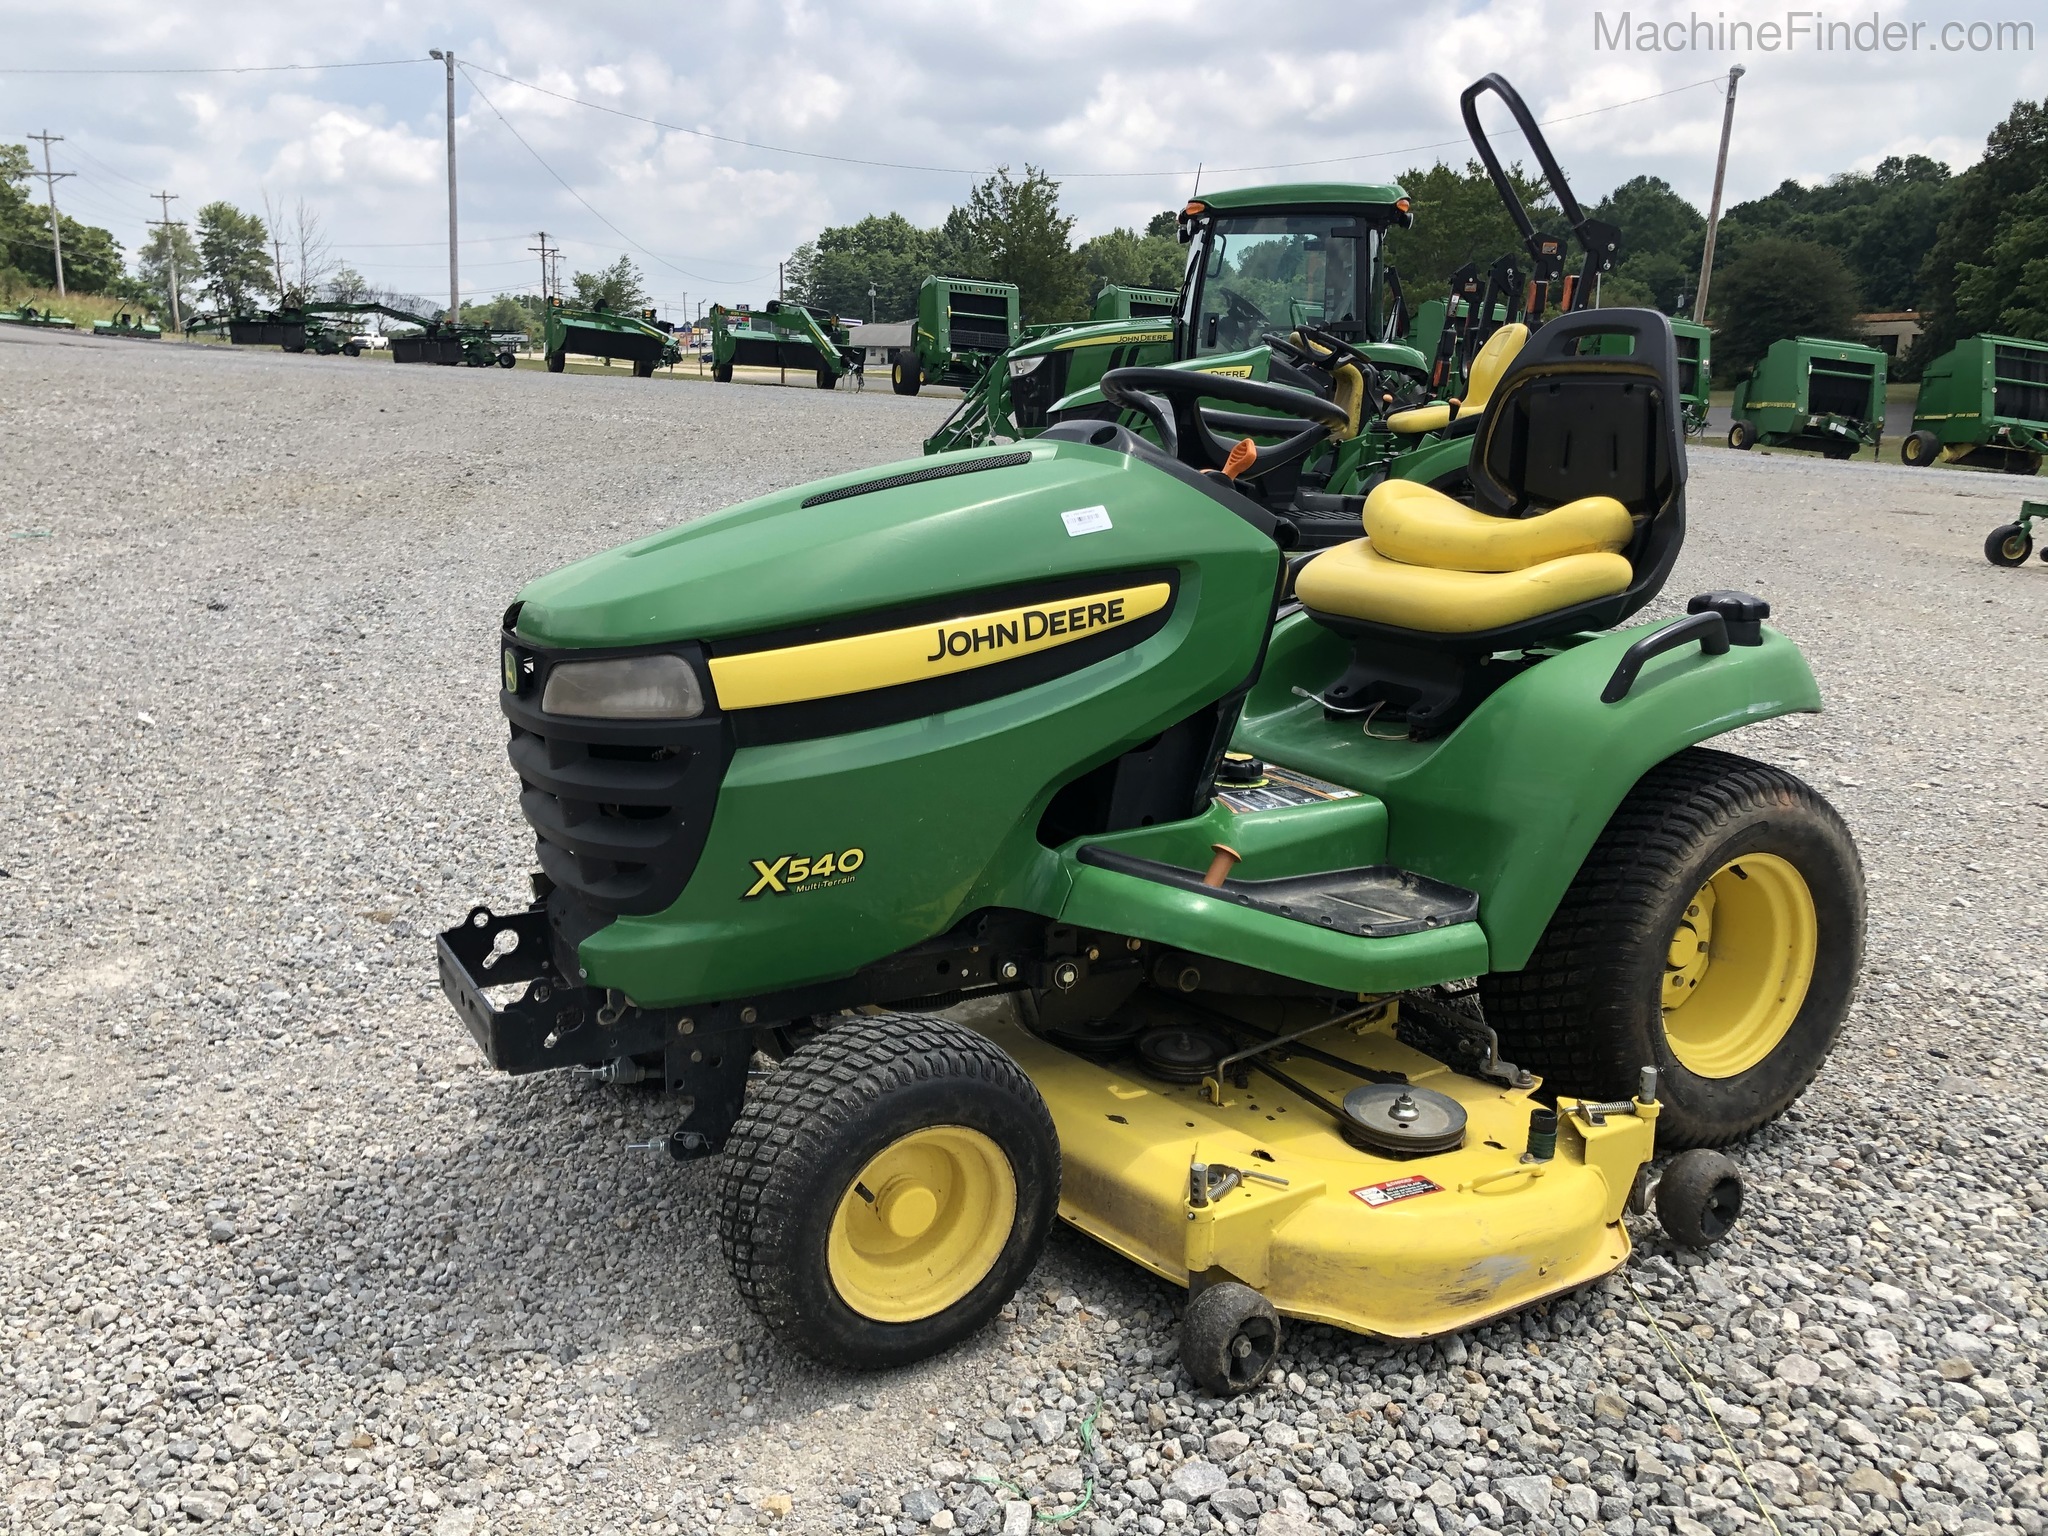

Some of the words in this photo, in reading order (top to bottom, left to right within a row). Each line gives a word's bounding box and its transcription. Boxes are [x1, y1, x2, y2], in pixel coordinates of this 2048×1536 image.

[1117, 335, 1139, 344] JOHN
[1140, 334, 1168, 343] DEERE
[1210, 370, 1246, 379] DEERE
[928, 620, 1019, 662] JOHN
[1023, 597, 1125, 642] DEERE
[744, 848, 865, 898] X540
[795, 875, 856, 893] Multi-Terrain
